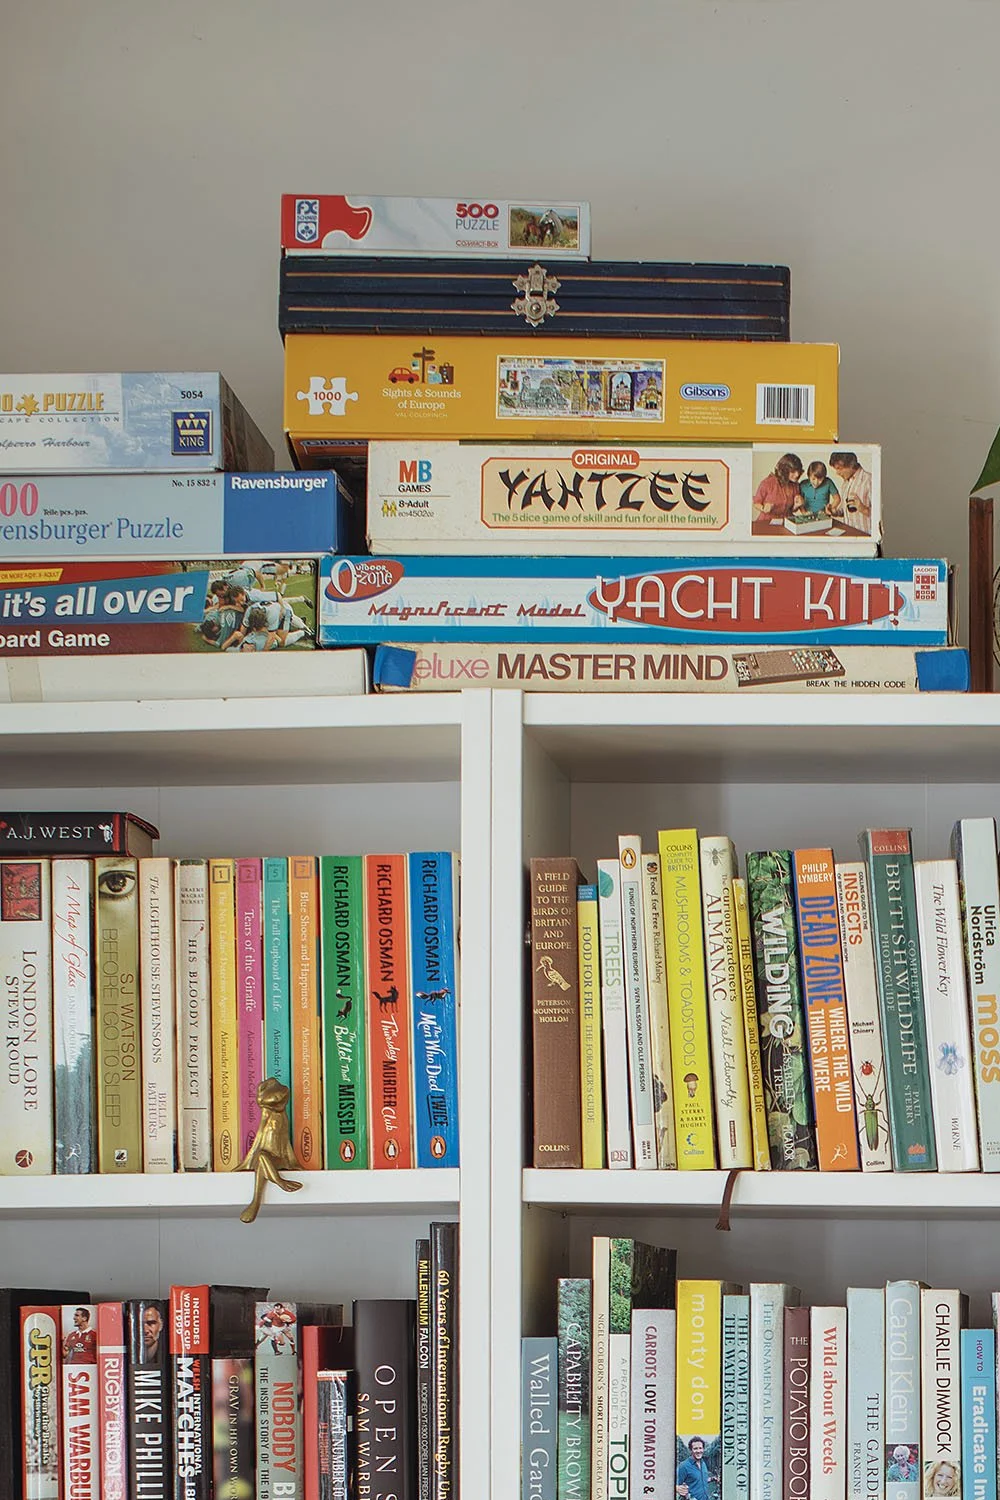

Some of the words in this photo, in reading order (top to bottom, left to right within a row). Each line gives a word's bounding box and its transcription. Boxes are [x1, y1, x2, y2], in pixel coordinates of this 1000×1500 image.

[455, 219, 499, 230] PUZZLE
[456, 203, 499, 219] 500
[43, 393, 104, 411] PUZZLE
[181, 391, 203, 399] 5054
[313, 392, 341, 400] 1000
[383, 388, 411, 399] Sights
[414, 388, 423, 397] &
[425, 388, 461, 399] Sounds
[398, 400, 407, 409] of
[410, 401, 445, 411] Europe
[684, 387, 726, 397] Gibsons
[179, 437, 204, 447] KING
[575, 454, 636, 466] ORIGINAL
[231, 476, 327, 492] Ravensburger
[400, 460, 432, 482] MB
[399, 500, 429, 508] 8-Adult
[499, 469, 711, 512] YAHTZEE
[117, 518, 183, 538] Puzzle
[493, 513, 511, 522] The
[513, 514, 519, 522] 5
[520, 514, 541, 522] dice
[542, 516, 569, 524] game
[572, 514, 582, 522] of
[583, 514, 602, 523] skill
[604, 514, 623, 523] and
[625, 514, 640, 523] fun
[643, 515, 656, 523] for
[658, 515, 669, 523] all
[670, 515, 686, 523] the
[687, 515, 718, 525] family.
[3, 592, 46, 617] it's
[55, 586, 97, 616] all
[104, 586, 194, 614] over
[368, 601, 508, 621] Magnificent
[517, 603, 586, 617] Model
[595, 575, 774, 623] YACHT
[803, 577, 899, 627] KIT!
[48, 630, 110, 646] Game
[413, 653, 490, 679] eluxe
[497, 654, 635, 681] MASTER
[643, 655, 728, 681] MIND
[40, 826, 94, 840] WEST
[799, 872, 833, 883] LYMBERY
[802, 864, 828, 874] PHILIP
[800, 895, 836, 953] DEAD
[844, 872, 863, 945] INSECTS
[982, 905, 996, 947] Ulrica
[336, 931, 351, 988] OSMAN
[378, 928, 394, 983] OSMAN
[423, 925, 440, 982] OSMAN
[970, 906, 984, 985] Nordström
[759, 911, 793, 1039] WILDING
[804, 954, 842, 1004] ZONE
[883, 863, 905, 960] BRITISH
[894, 968, 918, 1077] WILDLIFE
[22, 950, 39, 1044] LONDON
[22, 1051, 38, 1111] LORE
[688, 1294, 707, 1367] monty
[936, 1303, 951, 1370] CHARLIE
[67, 1371, 90, 1416] SAM
[134, 1369, 161, 1425] MIKE
[530, 1353, 550, 1435] Walled
[691, 1377, 708, 1422] don
[273, 1381, 296, 1473] NOBODY
[936, 1377, 953, 1454] DIMMOCK
[971, 1385, 988, 1474] Eradicate
